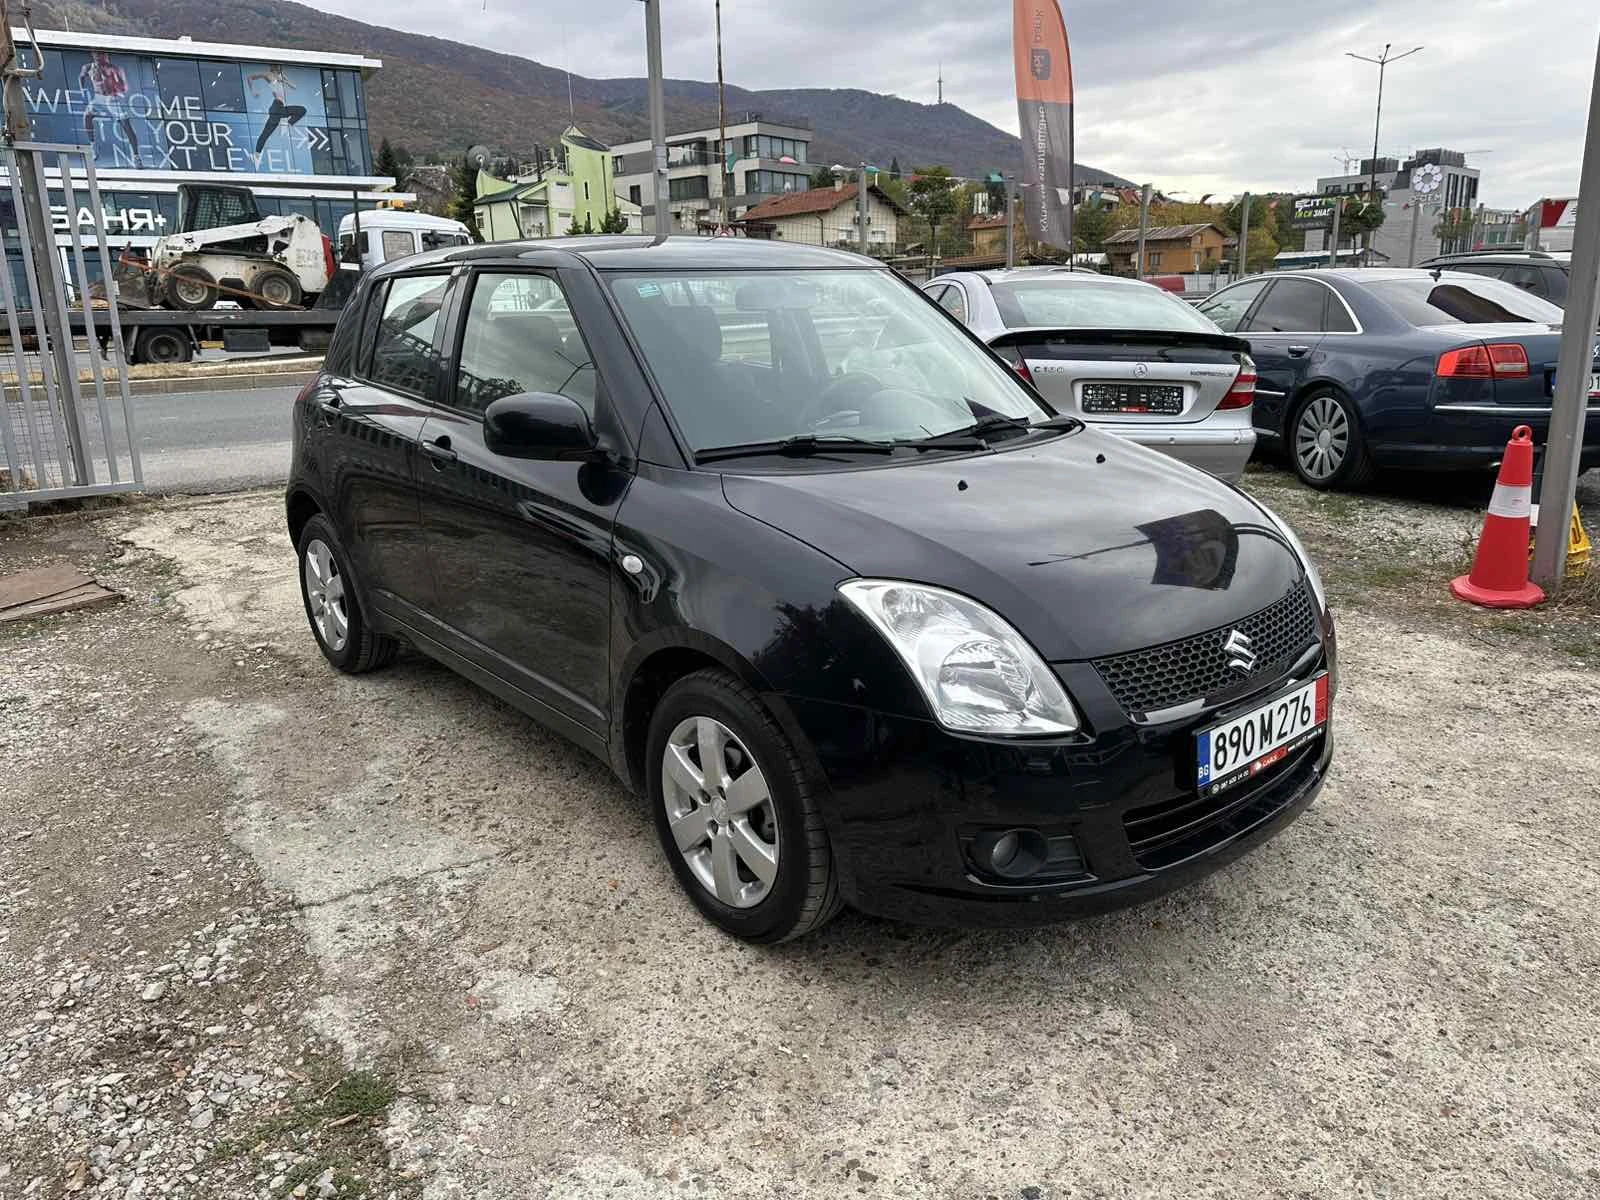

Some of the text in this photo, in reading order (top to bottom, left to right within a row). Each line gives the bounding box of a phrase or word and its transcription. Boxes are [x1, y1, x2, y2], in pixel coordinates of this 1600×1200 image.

[23, 88, 203, 120] WELCOME
[92, 117, 234, 147] TO YOUR
[112, 143, 303, 173] NEXT LEVEL
[1198, 764, 1210, 779] BG
